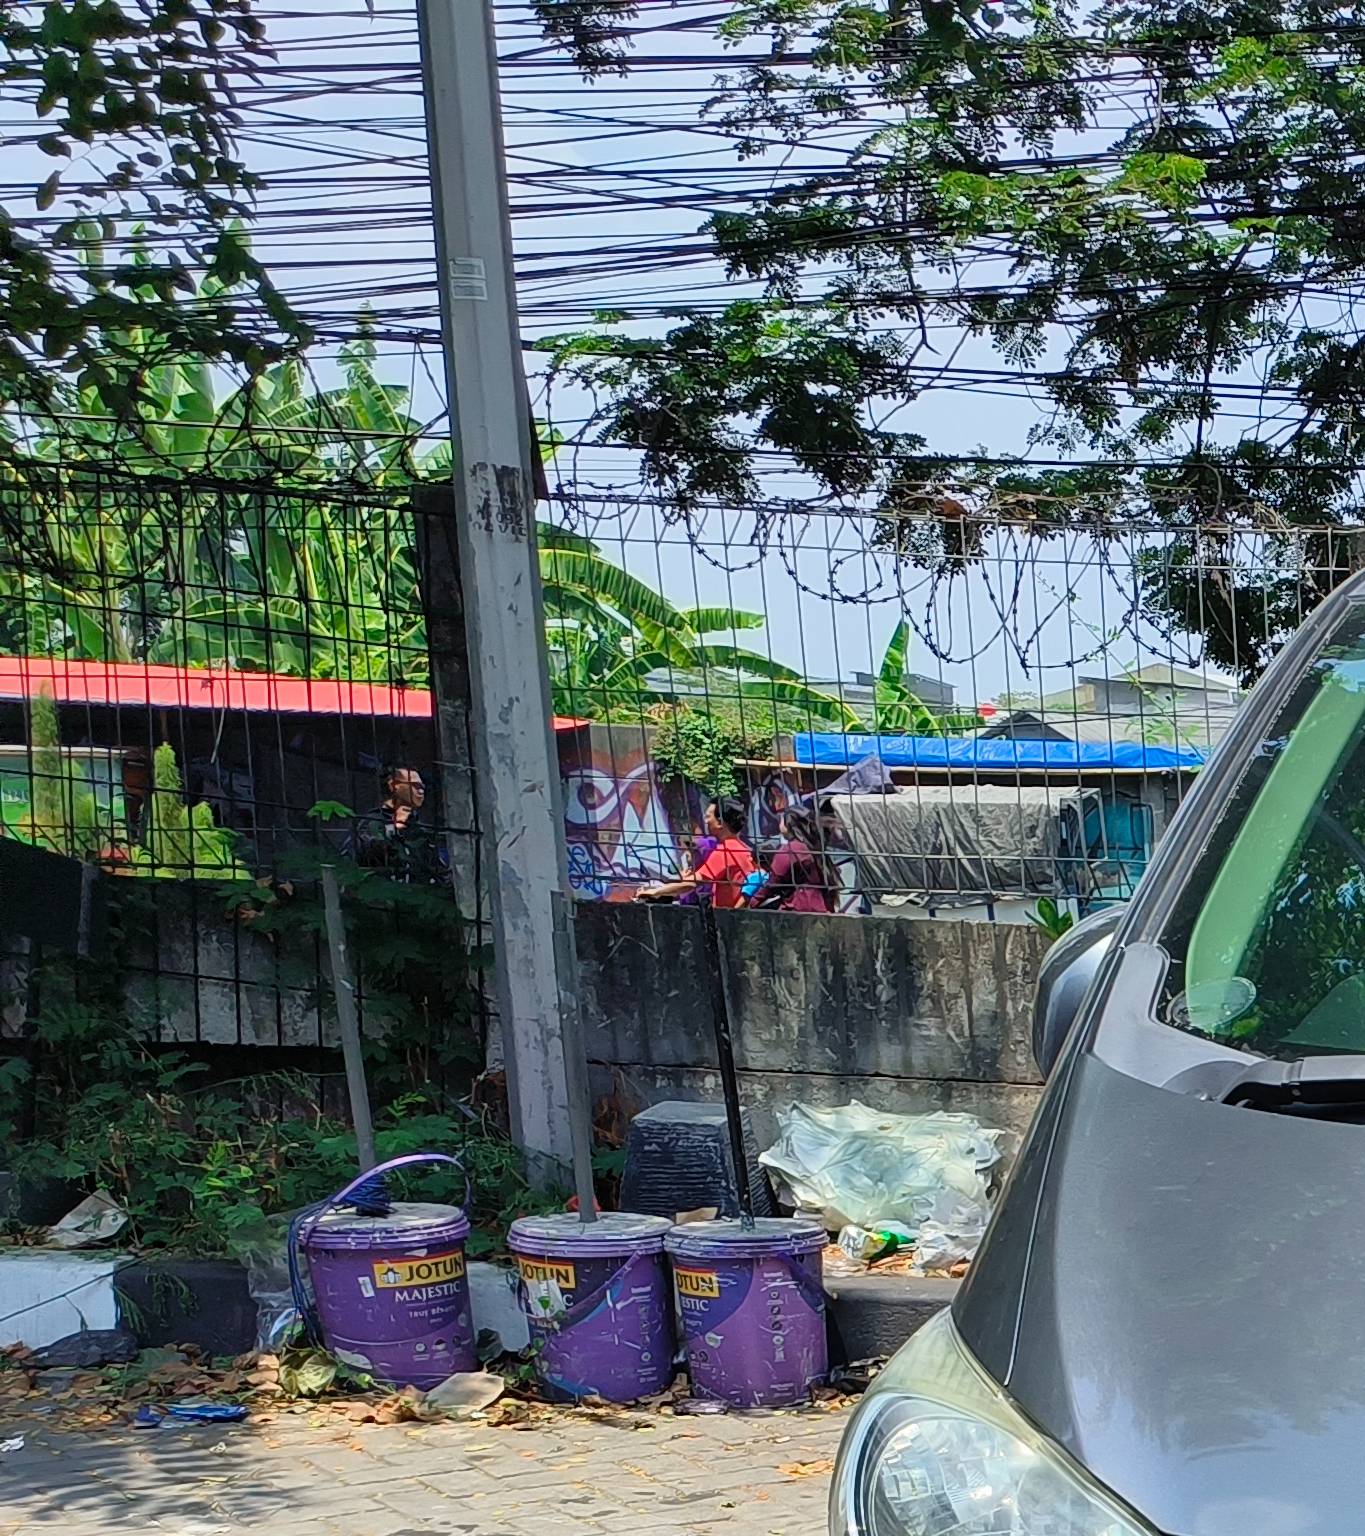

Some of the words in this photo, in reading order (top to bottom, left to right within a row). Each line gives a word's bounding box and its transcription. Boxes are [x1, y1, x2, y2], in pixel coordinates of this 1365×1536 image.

[405, 1256, 462, 1282] JOTUN
[395, 1281, 460, 1302] MAJESTIC
[676, 1271, 714, 1292] OTUN
